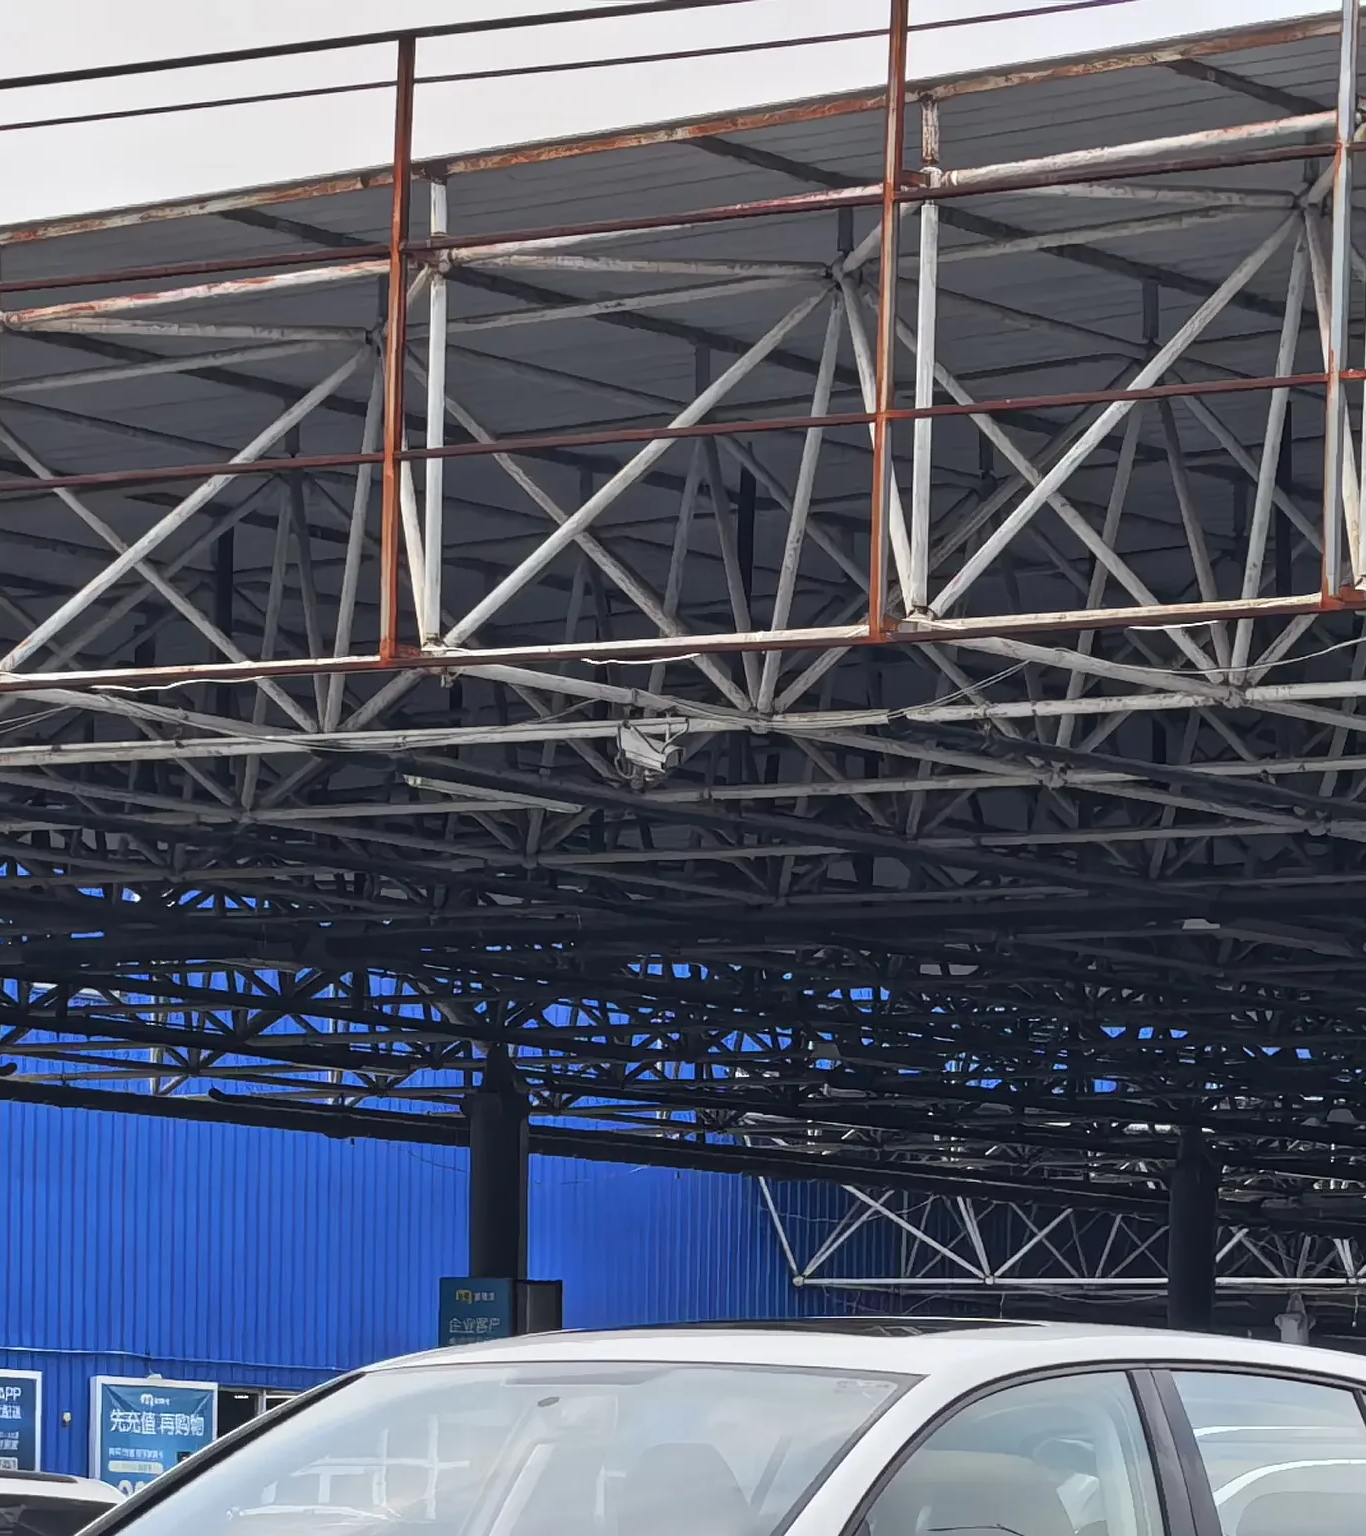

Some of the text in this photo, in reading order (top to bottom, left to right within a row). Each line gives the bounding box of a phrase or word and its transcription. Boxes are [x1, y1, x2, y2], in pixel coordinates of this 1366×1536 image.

[109, 1408, 205, 1437] 先充值 再购物
